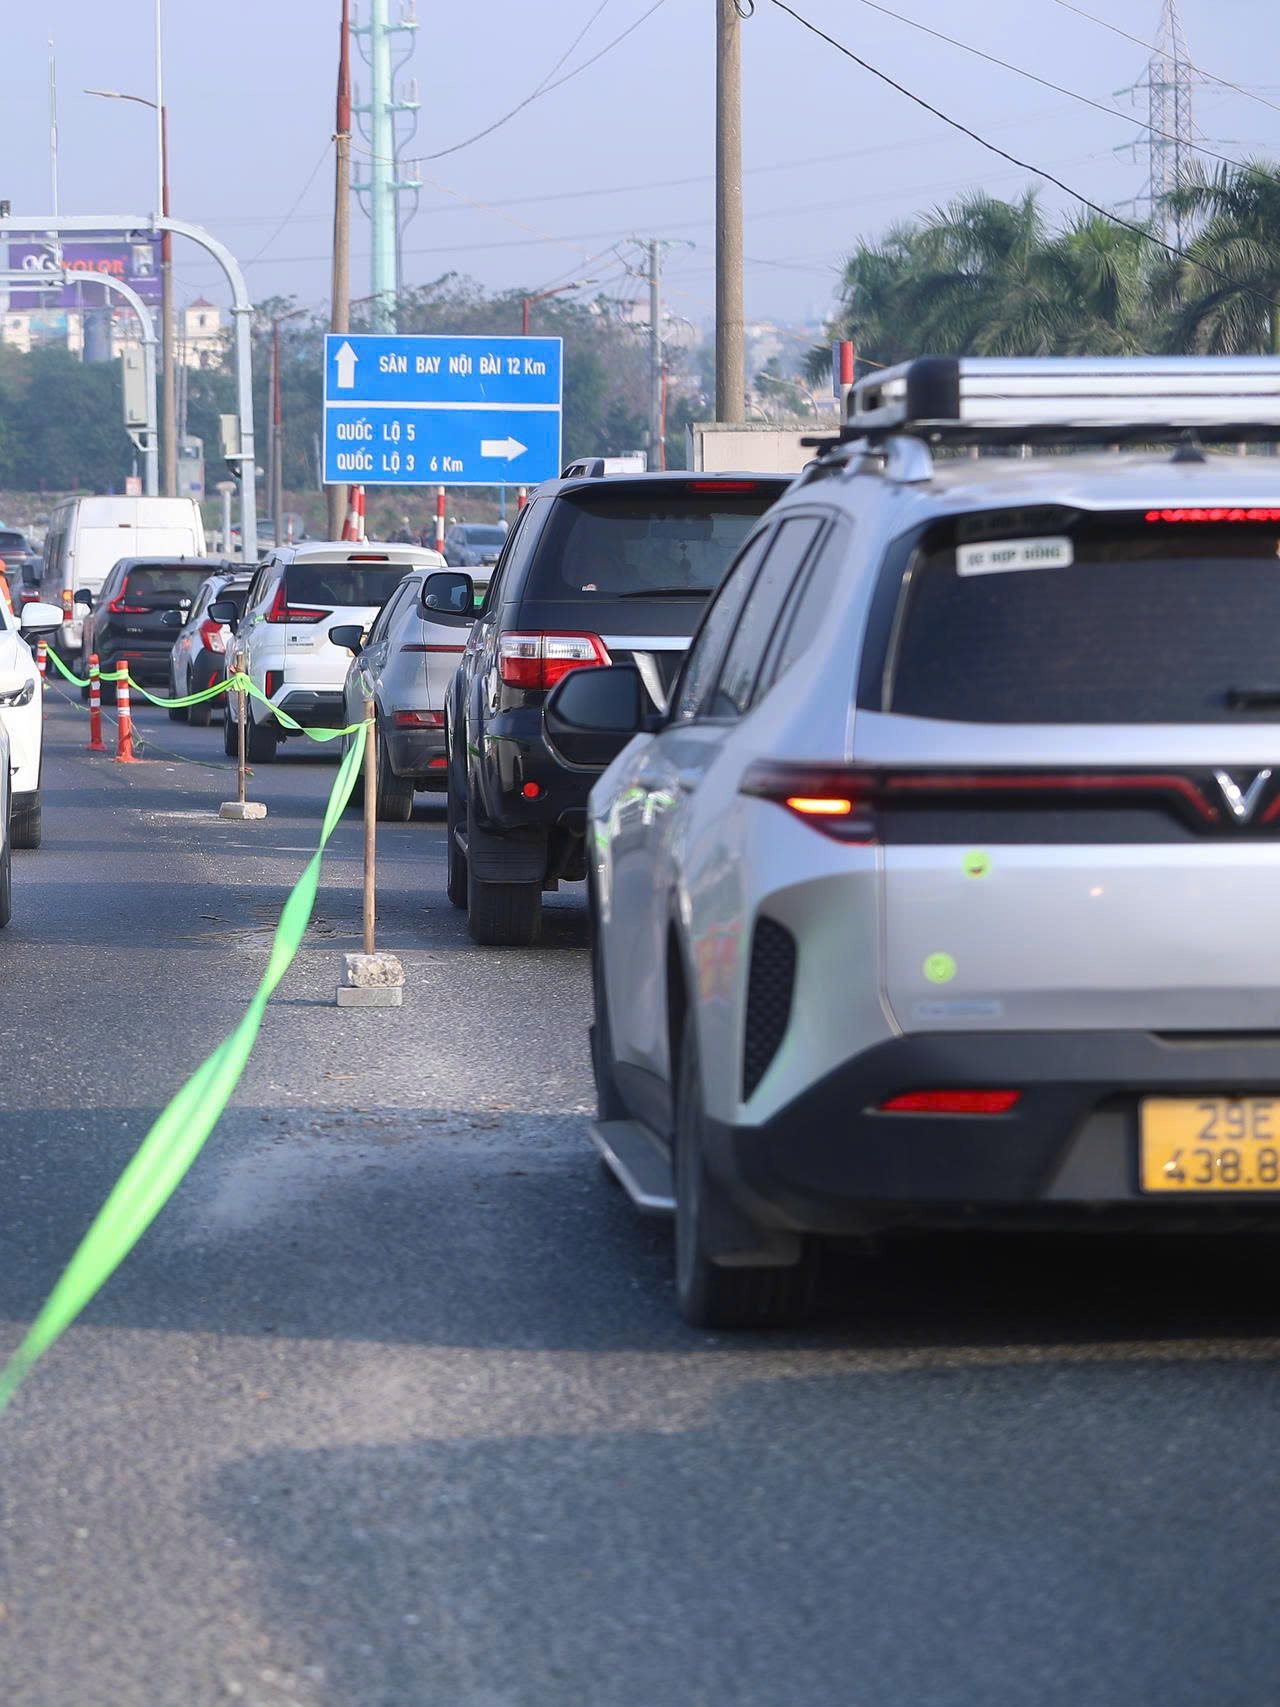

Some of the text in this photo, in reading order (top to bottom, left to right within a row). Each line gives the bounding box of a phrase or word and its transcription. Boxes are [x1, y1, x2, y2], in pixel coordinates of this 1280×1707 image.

[379, 353, 546, 378] SÂN BAY NỘI BÀI 12 Km
[336, 417, 416, 445] QUỐC LỘ 5
[337, 447, 464, 475] QUỐC LỘ 3 6 Km
[1195, 1101, 1275, 1141] 29E
[1162, 1147, 1280, 1184] 438.8
